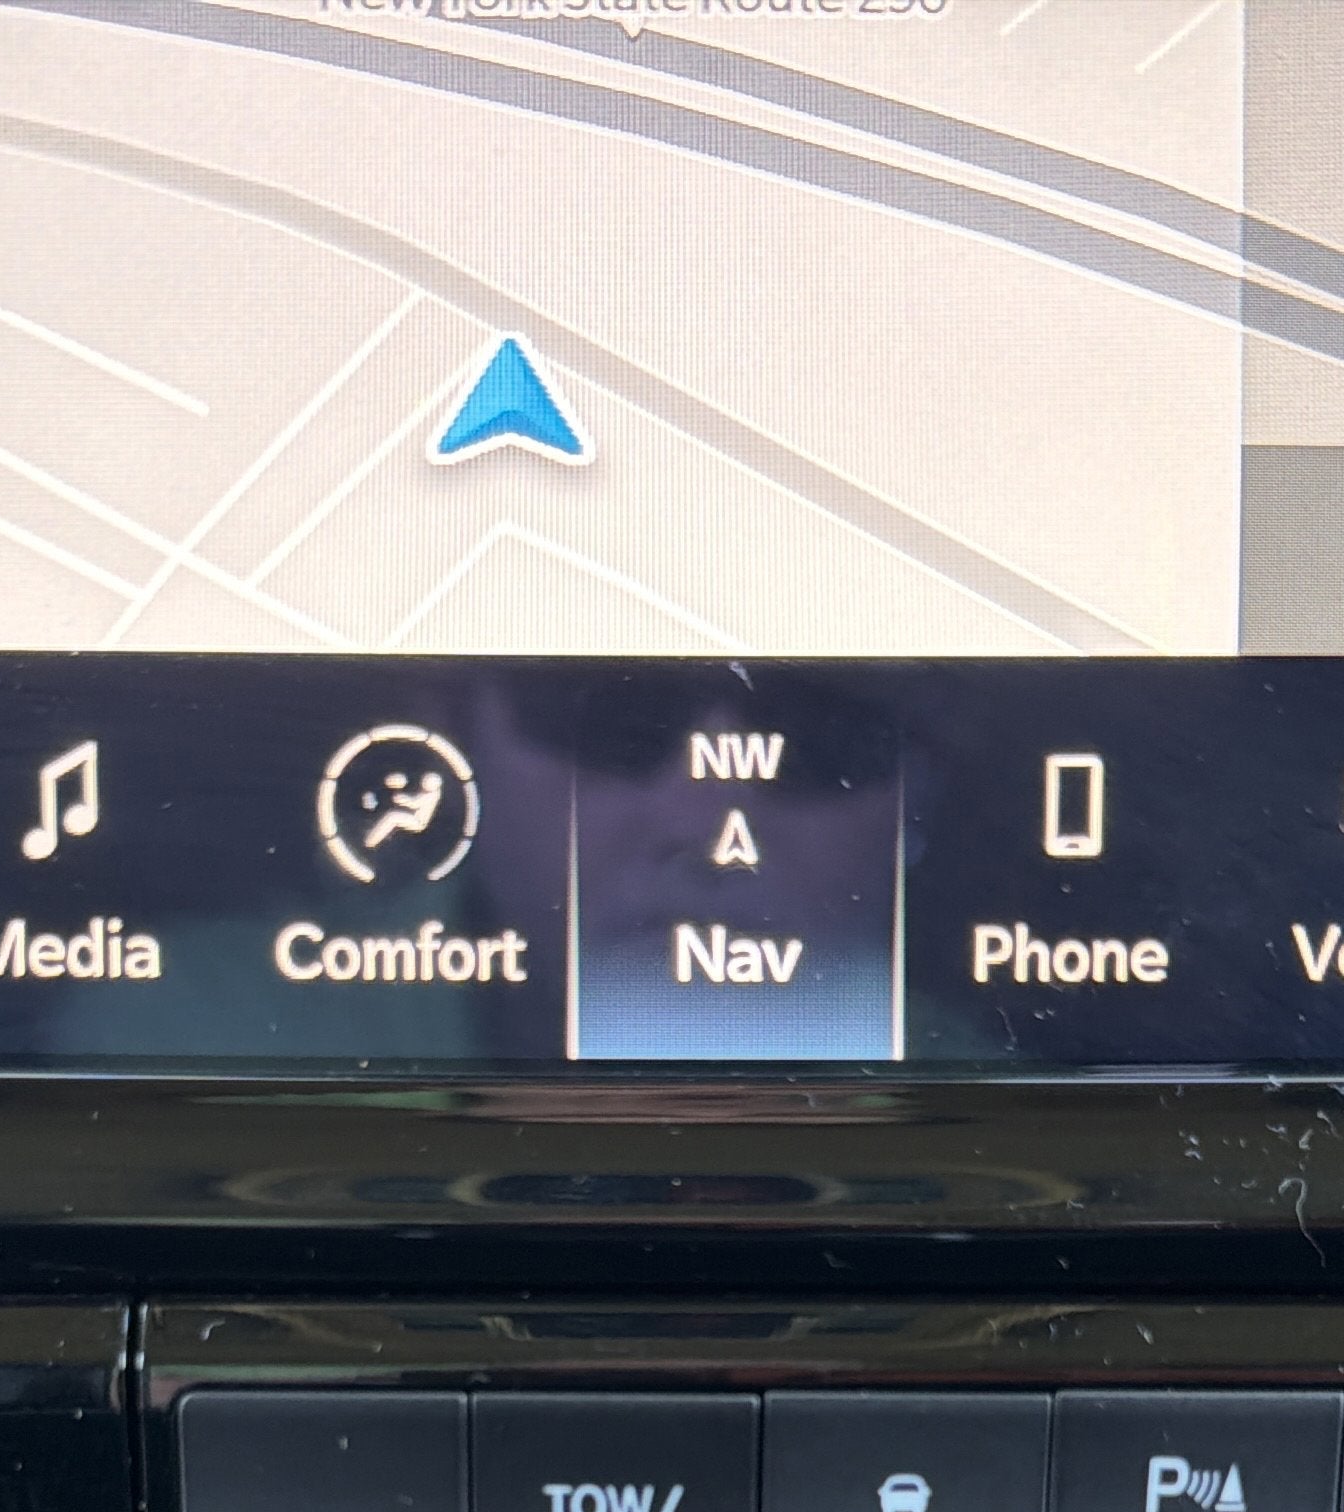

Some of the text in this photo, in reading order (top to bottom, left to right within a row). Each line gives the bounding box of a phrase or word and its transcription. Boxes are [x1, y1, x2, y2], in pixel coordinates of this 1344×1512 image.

[690, 732, 785, 780] NW
[274, 920, 528, 982] Comfort
[675, 923, 803, 983] Nav
[973, 922, 1169, 983] Phone
